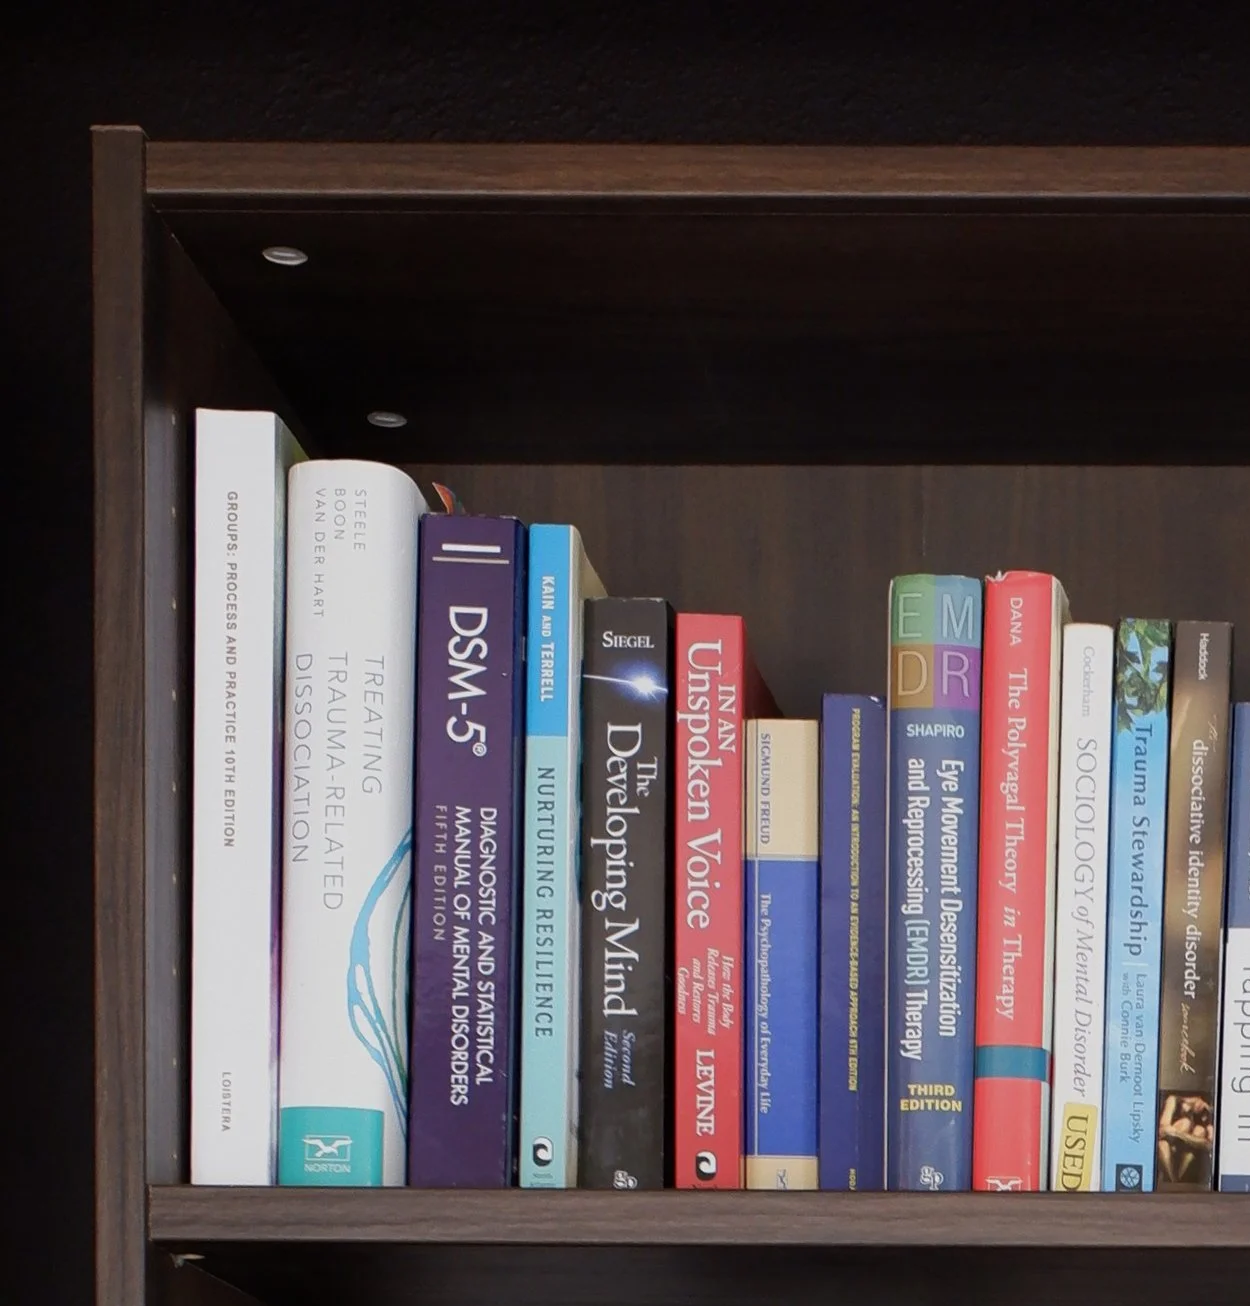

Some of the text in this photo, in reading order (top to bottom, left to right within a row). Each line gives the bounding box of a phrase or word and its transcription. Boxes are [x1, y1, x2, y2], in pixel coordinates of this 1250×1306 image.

[312, 487, 327, 618] VAN DER HART
[332, 487, 347, 541] BOON
[352, 488, 368, 551] STEELE
[1009, 597, 1024, 647] DANA
[223, 490, 239, 848] GROUPS: PROCESS AND PRACTICE 10TH EDITION
[361, 654, 386, 795] TREATING
[540, 575, 556, 703] KAIN AND TERRELL
[718, 684, 738, 753] IN AN
[287, 648, 314, 870] DISSOCIATION
[322, 650, 349, 911] TRAUMA-RELATED
[432, 804, 449, 941] FIFTH EDITION
[589, 722, 641, 1018] Developing Mind
[636, 756, 659, 797] The
[677, 641, 721, 930] Unspoken Voice
[995, 667, 1029, 1021] The Polyvagal Theory in Therapy
[1125, 722, 1154, 958] Trauma Stewardship
[449, 805, 474, 1106] MANUAL OF MENTAL DISORDERS
[474, 807, 498, 1086] DIAGNOSTIC AND STATISTICAL
[534, 766, 556, 1038] NURTURING RESILIENCE
[899, 758, 930, 1061] and Reprocessing (EMDR) Therapy
[937, 759, 965, 1037] Eye Movement Desensitization
[1072, 737, 1100, 1098] SOCIOLOGY of Mental Disorder
[695, 1049, 715, 1137] LEVINE
